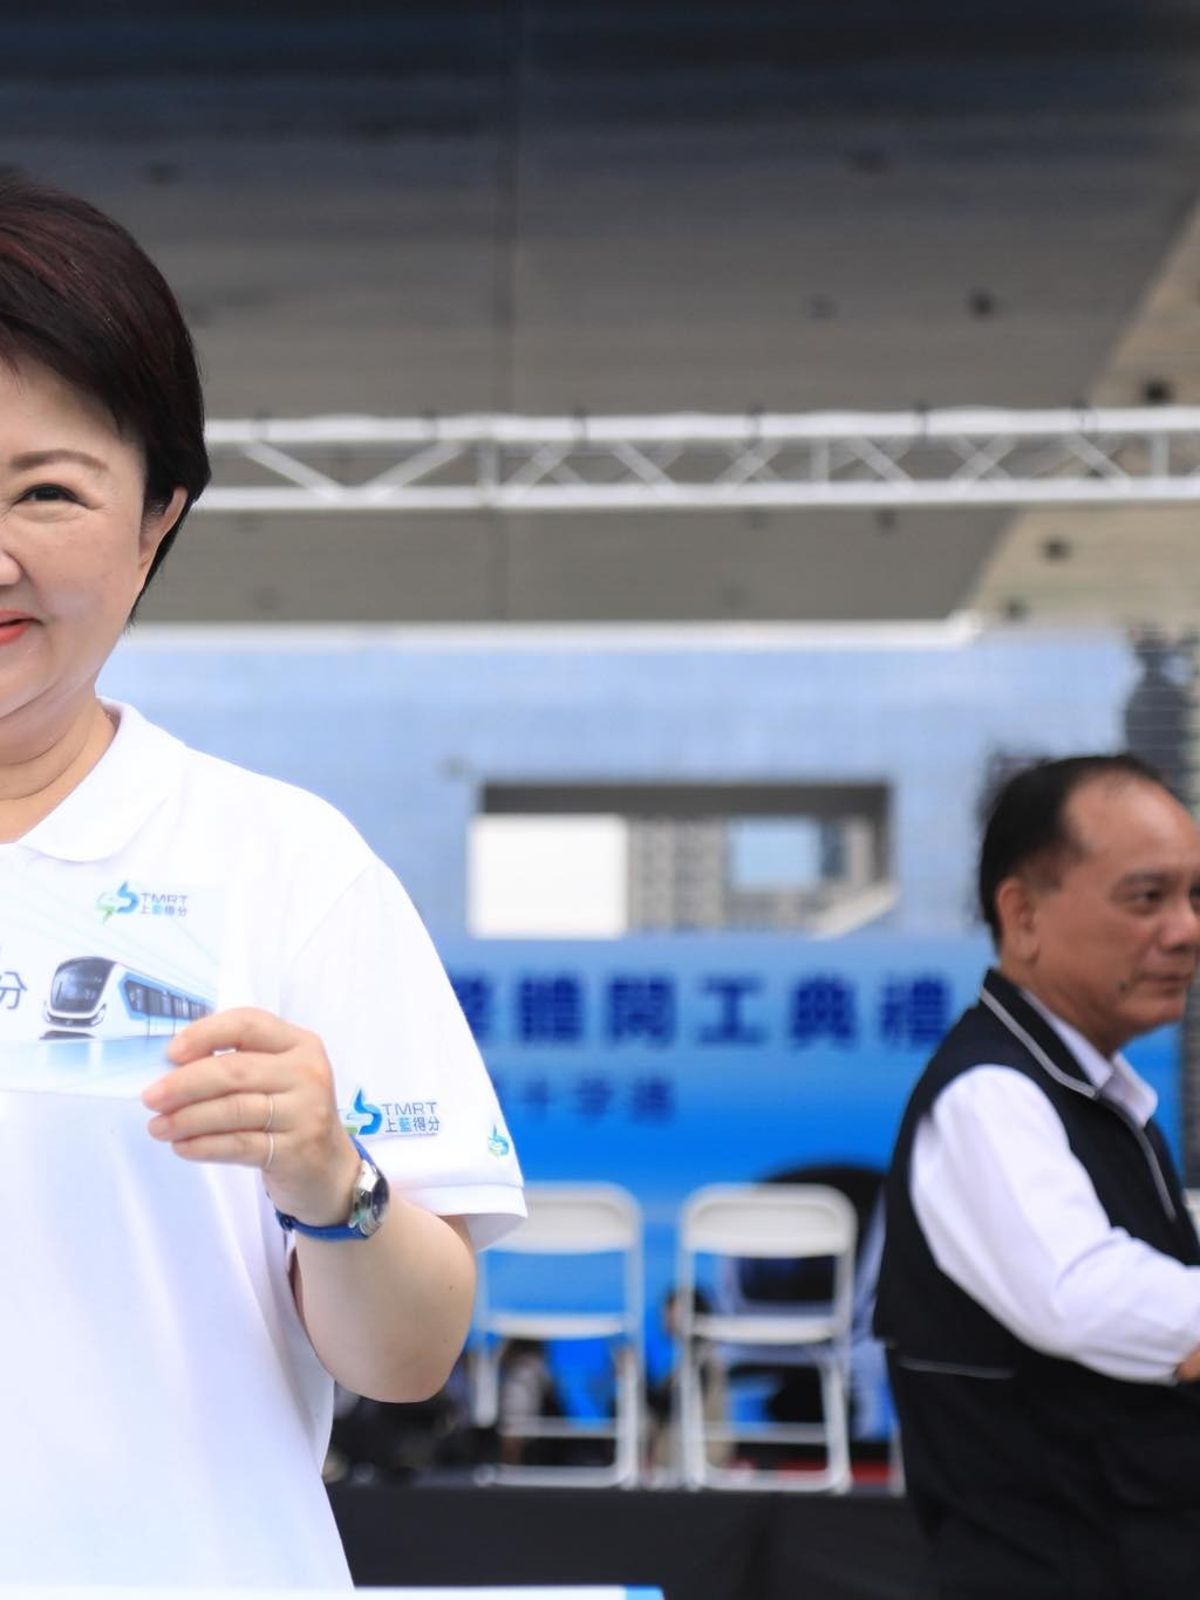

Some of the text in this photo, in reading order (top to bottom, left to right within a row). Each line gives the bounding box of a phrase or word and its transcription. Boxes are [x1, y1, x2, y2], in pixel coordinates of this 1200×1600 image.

[140, 892, 188, 905] TMRT
[381, 1101, 437, 1116] TMRT
[384, 1116, 440, 1133] 上藍得分
